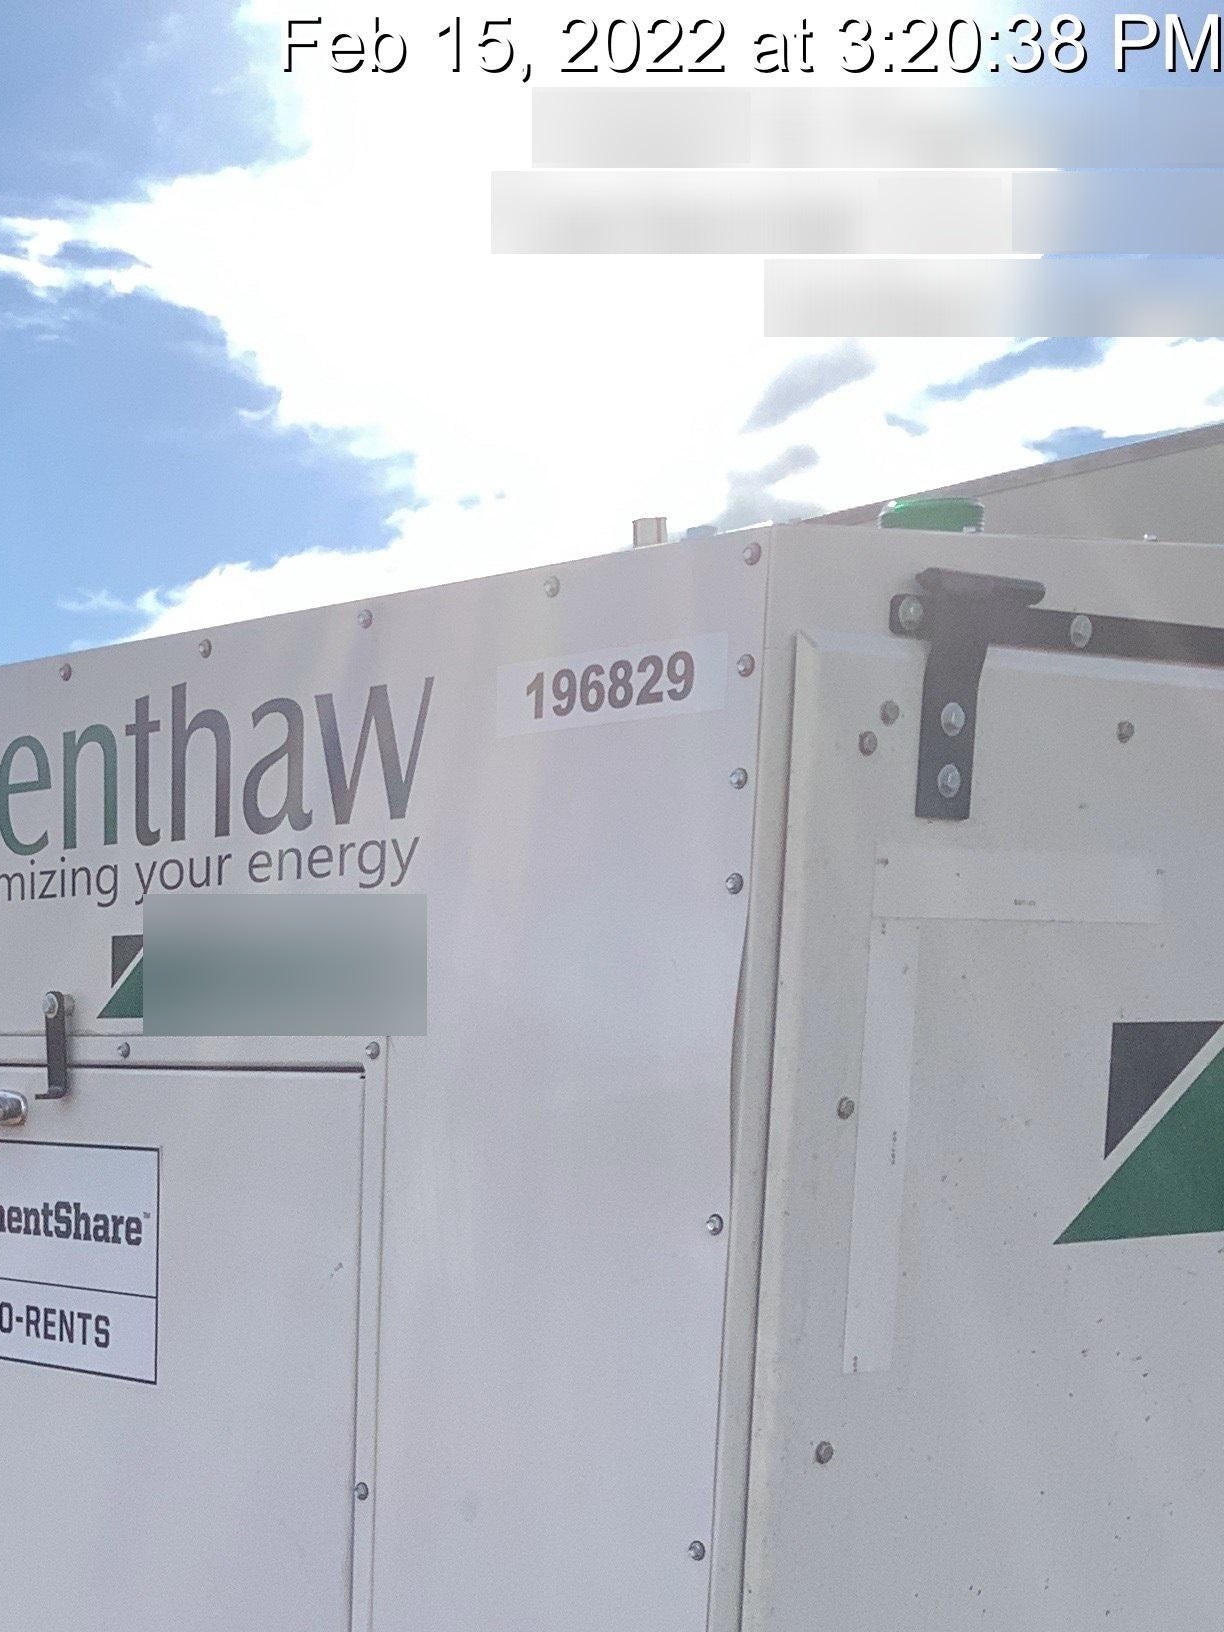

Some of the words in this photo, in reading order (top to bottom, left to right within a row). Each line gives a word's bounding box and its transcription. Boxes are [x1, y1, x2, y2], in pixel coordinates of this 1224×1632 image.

[526, 650, 695, 719] 196829
[134, 853, 233, 901] your
[247, 836, 421, 889] energy
